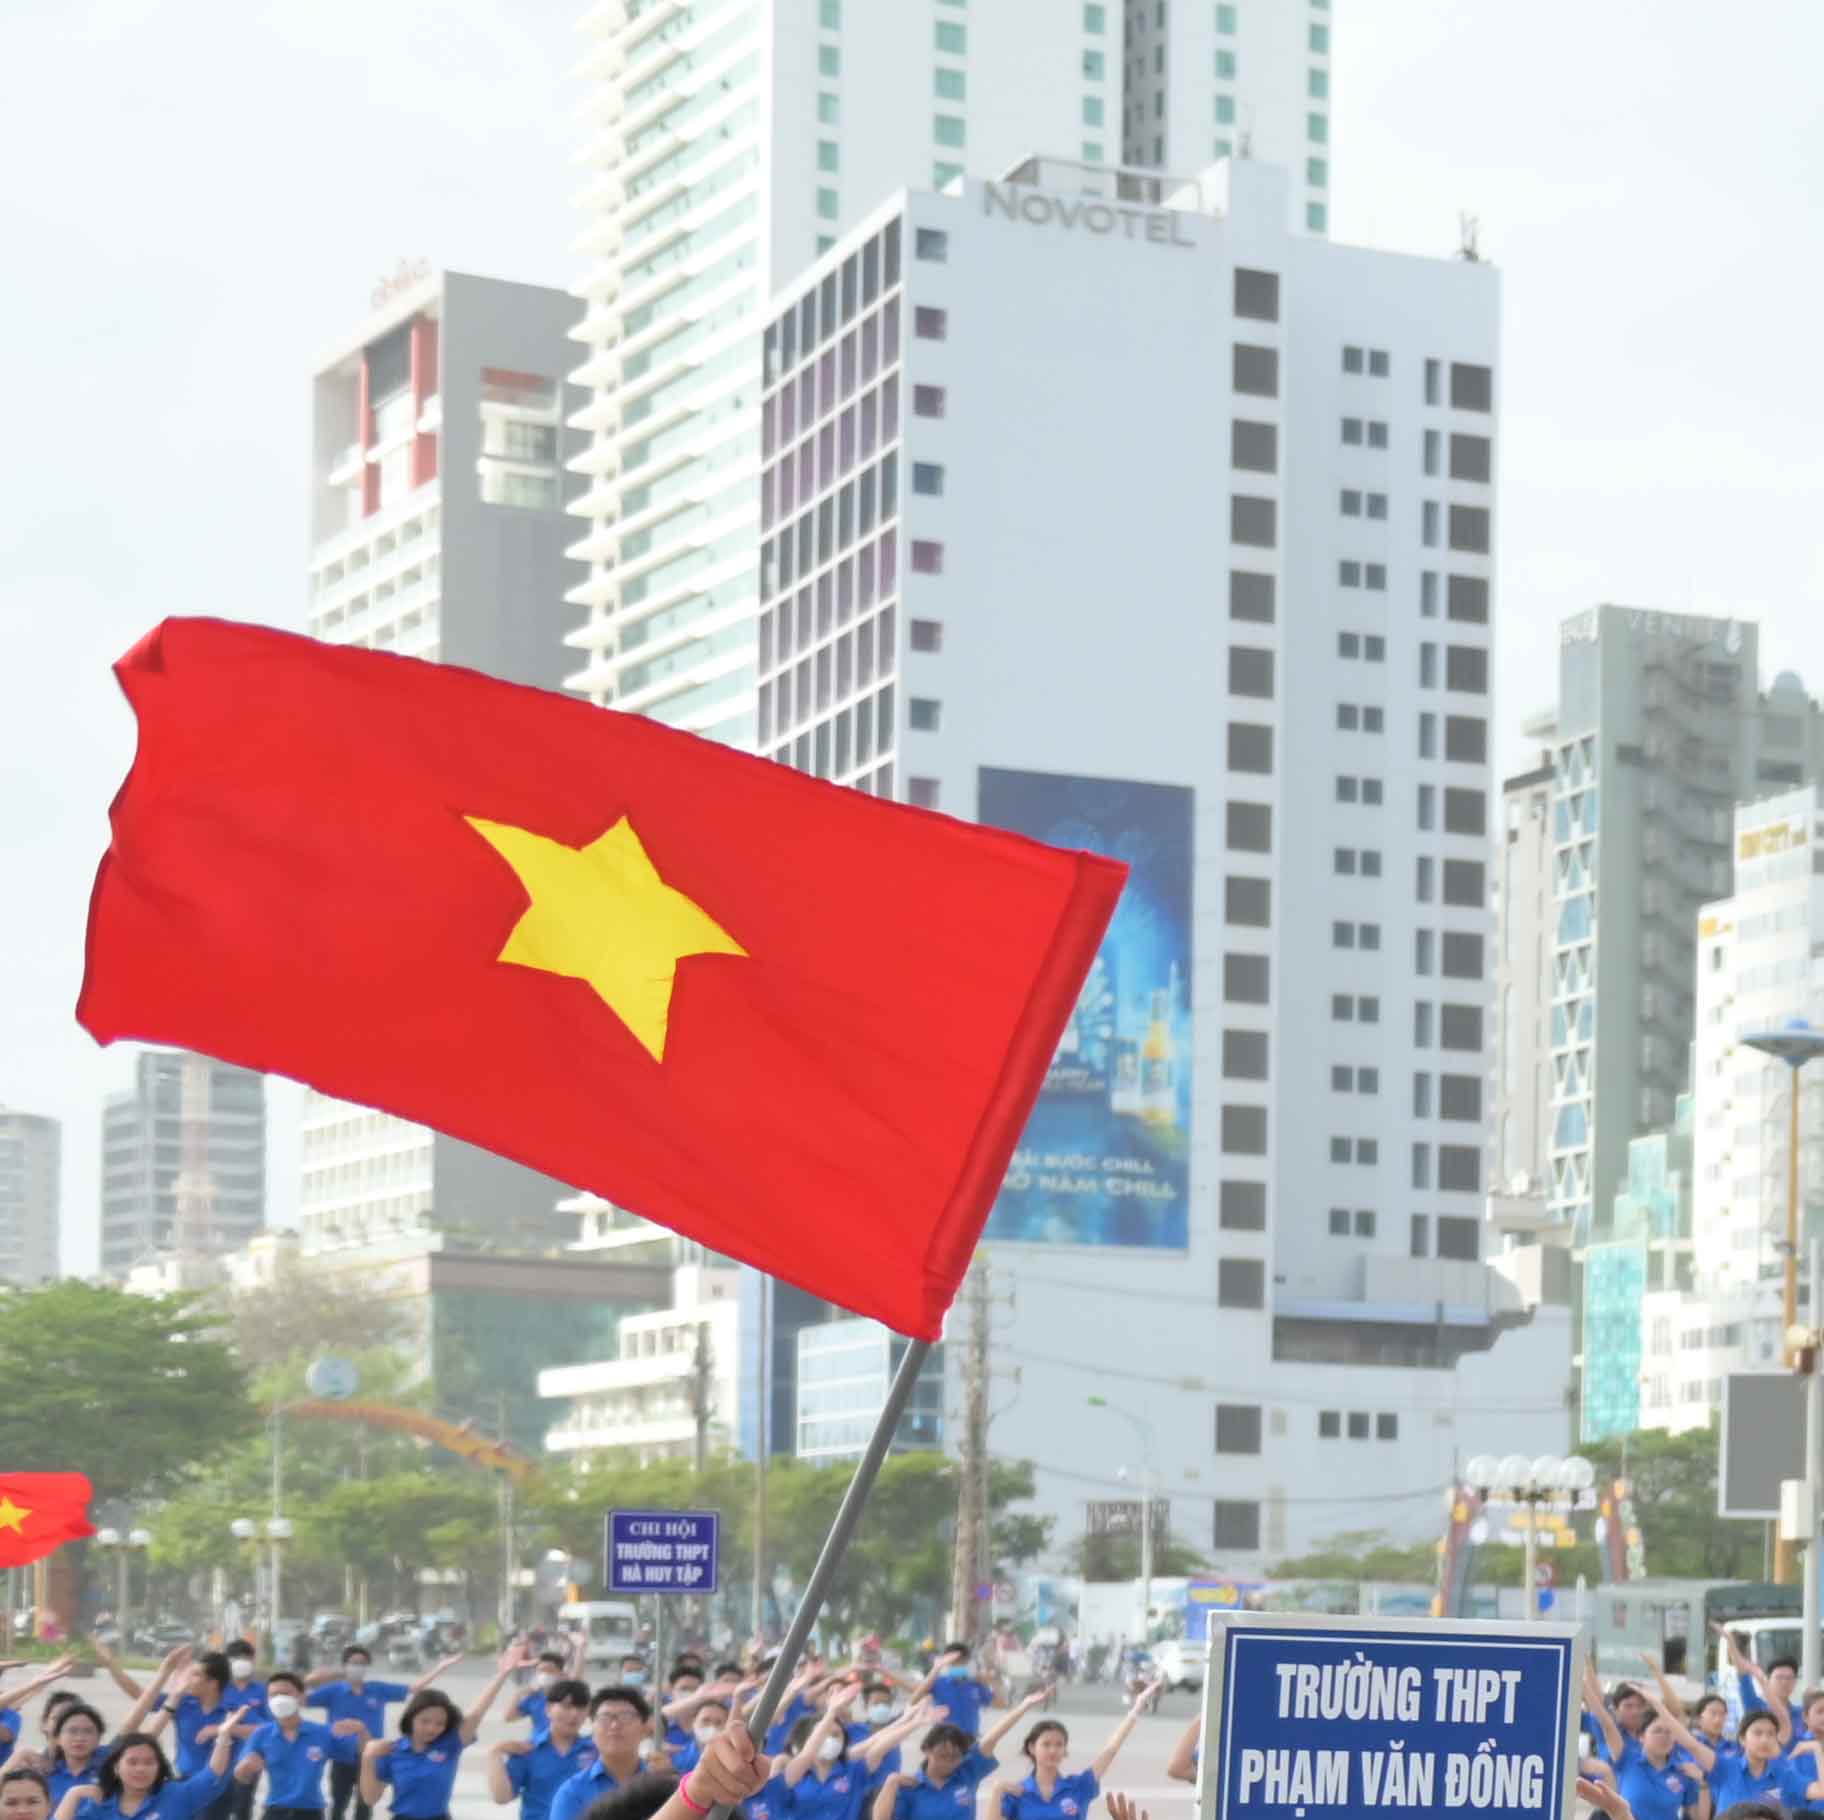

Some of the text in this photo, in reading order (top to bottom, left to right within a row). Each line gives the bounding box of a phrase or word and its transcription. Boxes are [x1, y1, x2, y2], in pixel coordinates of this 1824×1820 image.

[983, 180, 1196, 248] NOVOTEL
[629, 1518, 697, 1540] CHI HỘI
[676, 1543, 709, 1561] THPT
[645, 1565, 673, 1583] HUY
[677, 1562, 703, 1587] TẬP
[1276, 1652, 1522, 1724] TRƯỜNG THPT
[1239, 1738, 1543, 1817] PHẠM VĂN ĐỒNG
